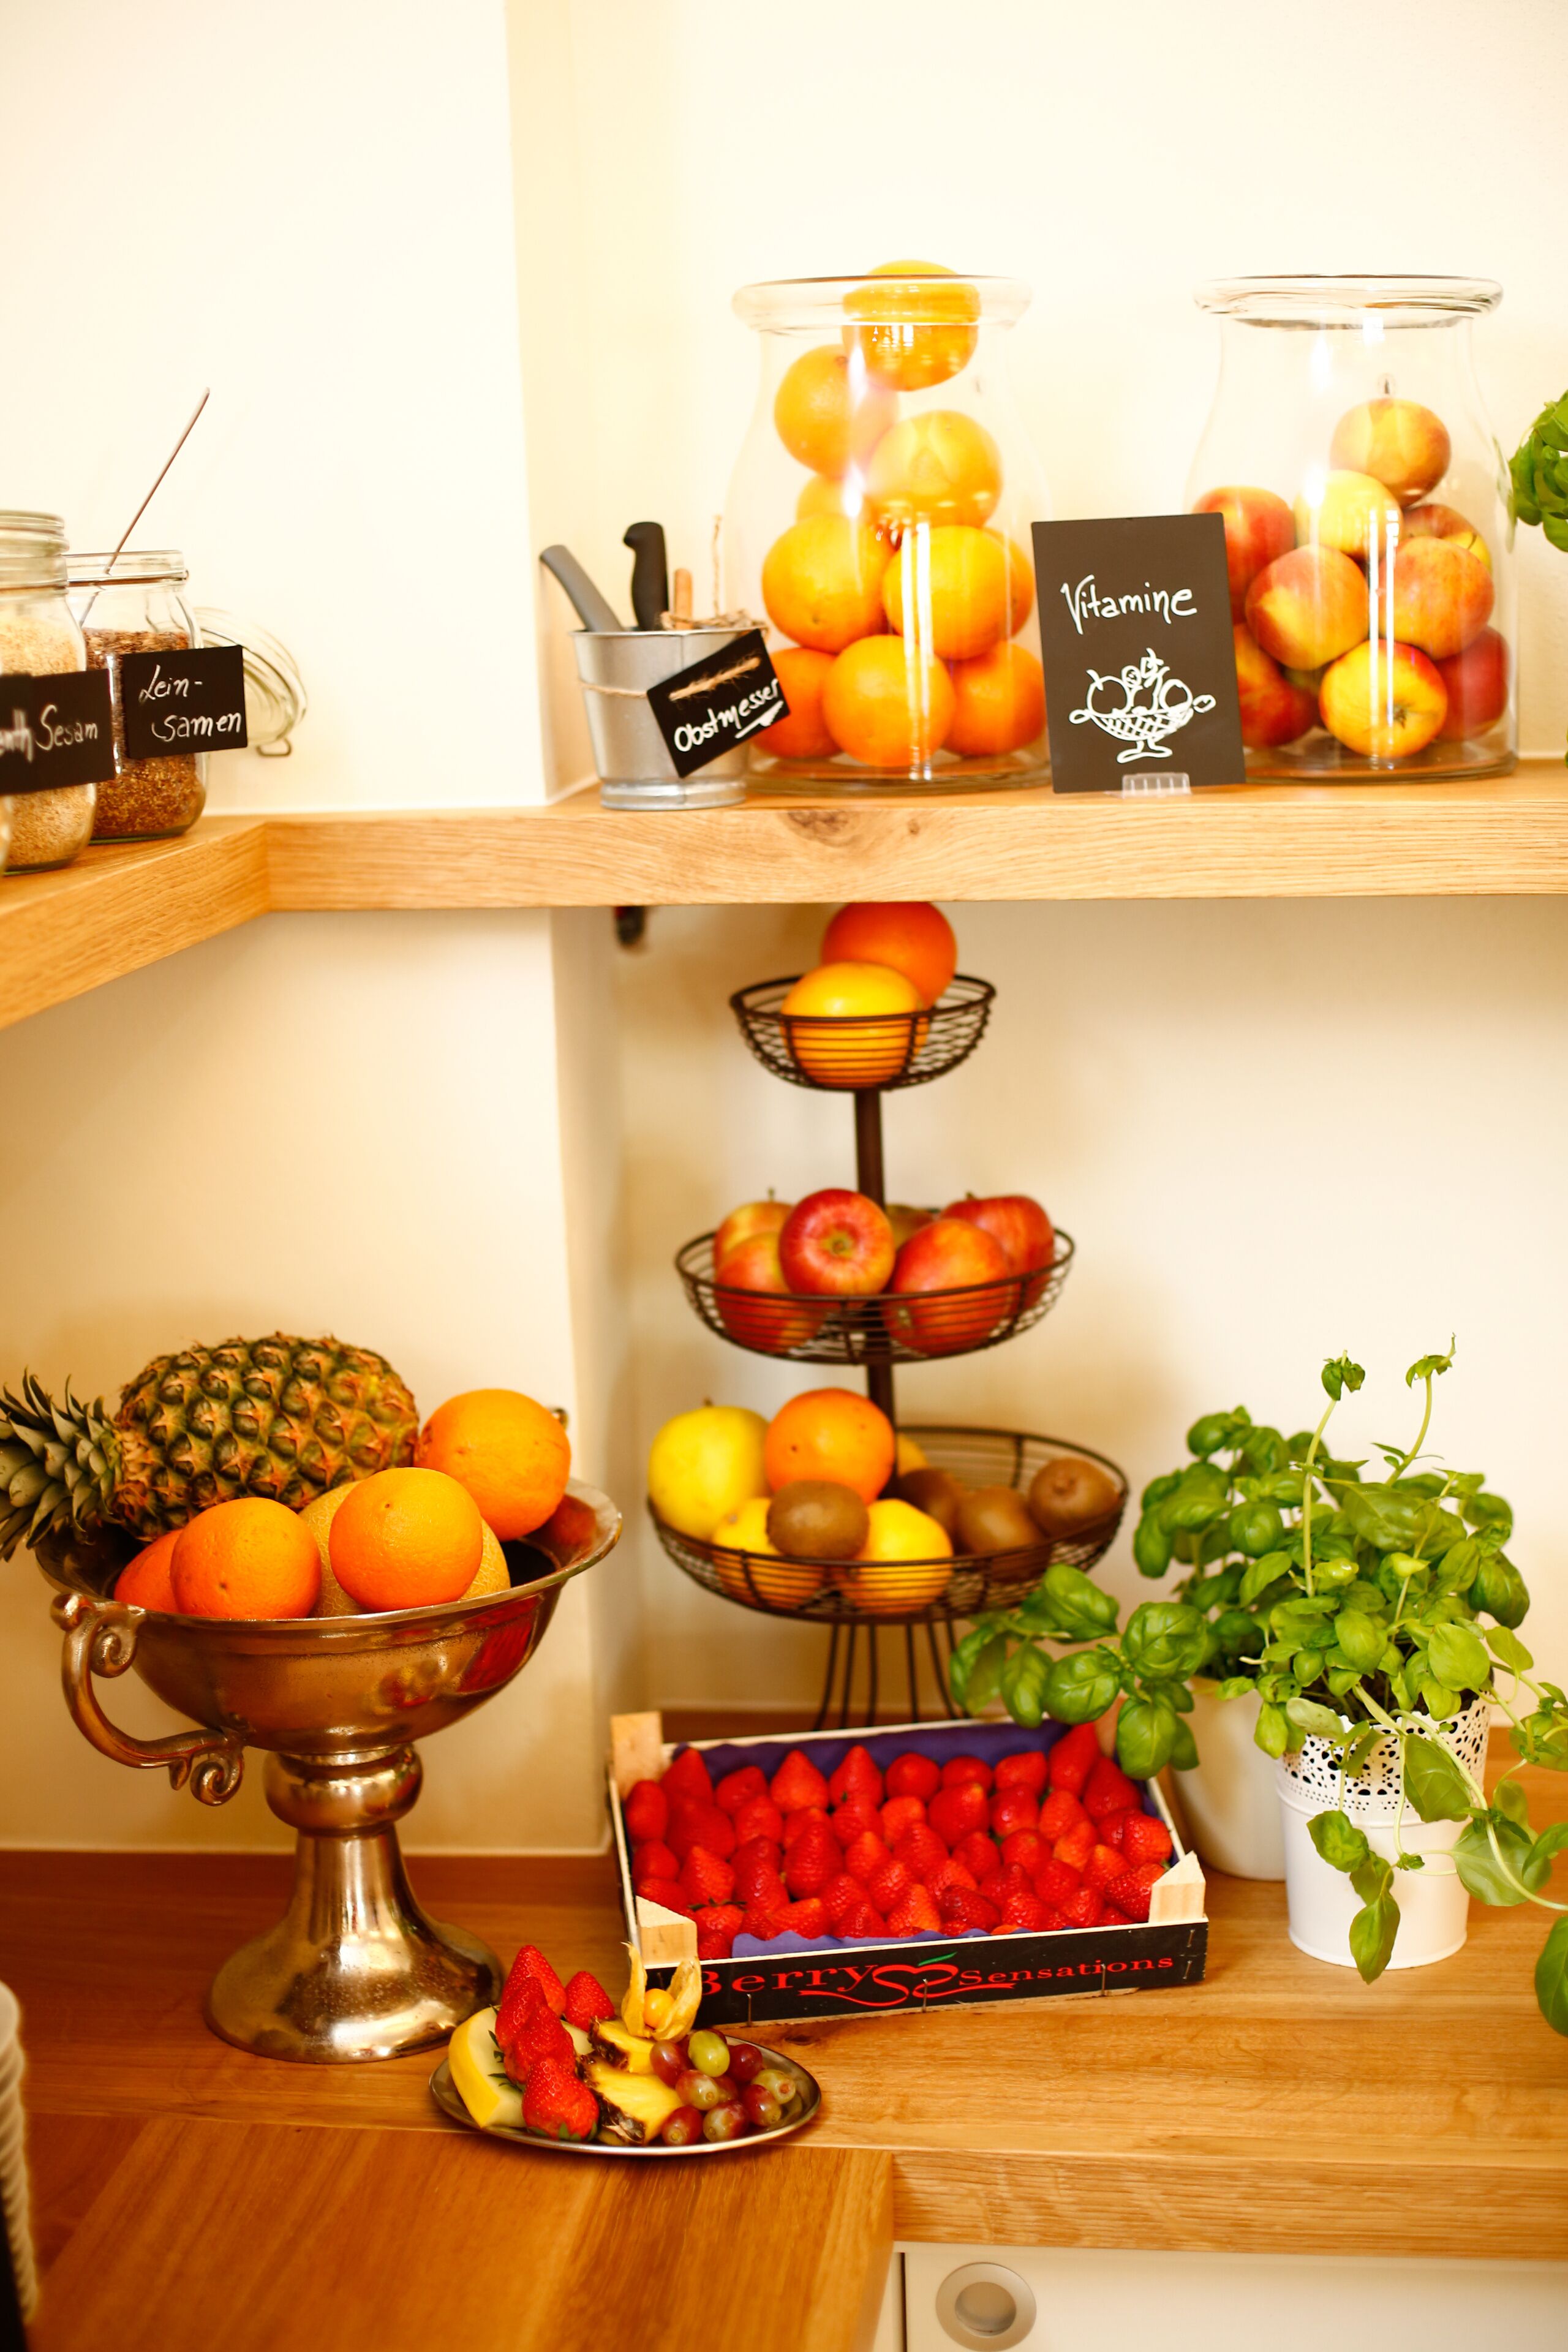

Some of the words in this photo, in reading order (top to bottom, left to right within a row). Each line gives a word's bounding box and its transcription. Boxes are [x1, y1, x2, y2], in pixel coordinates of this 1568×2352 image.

[1060, 574, 1197, 635] Vitamine
[138, 664, 203, 701] Lein-
[35, 704, 99, 751] Sesam
[674, 678, 779, 752] Obstmesser
[959, 1957, 1174, 1986] Sensations
